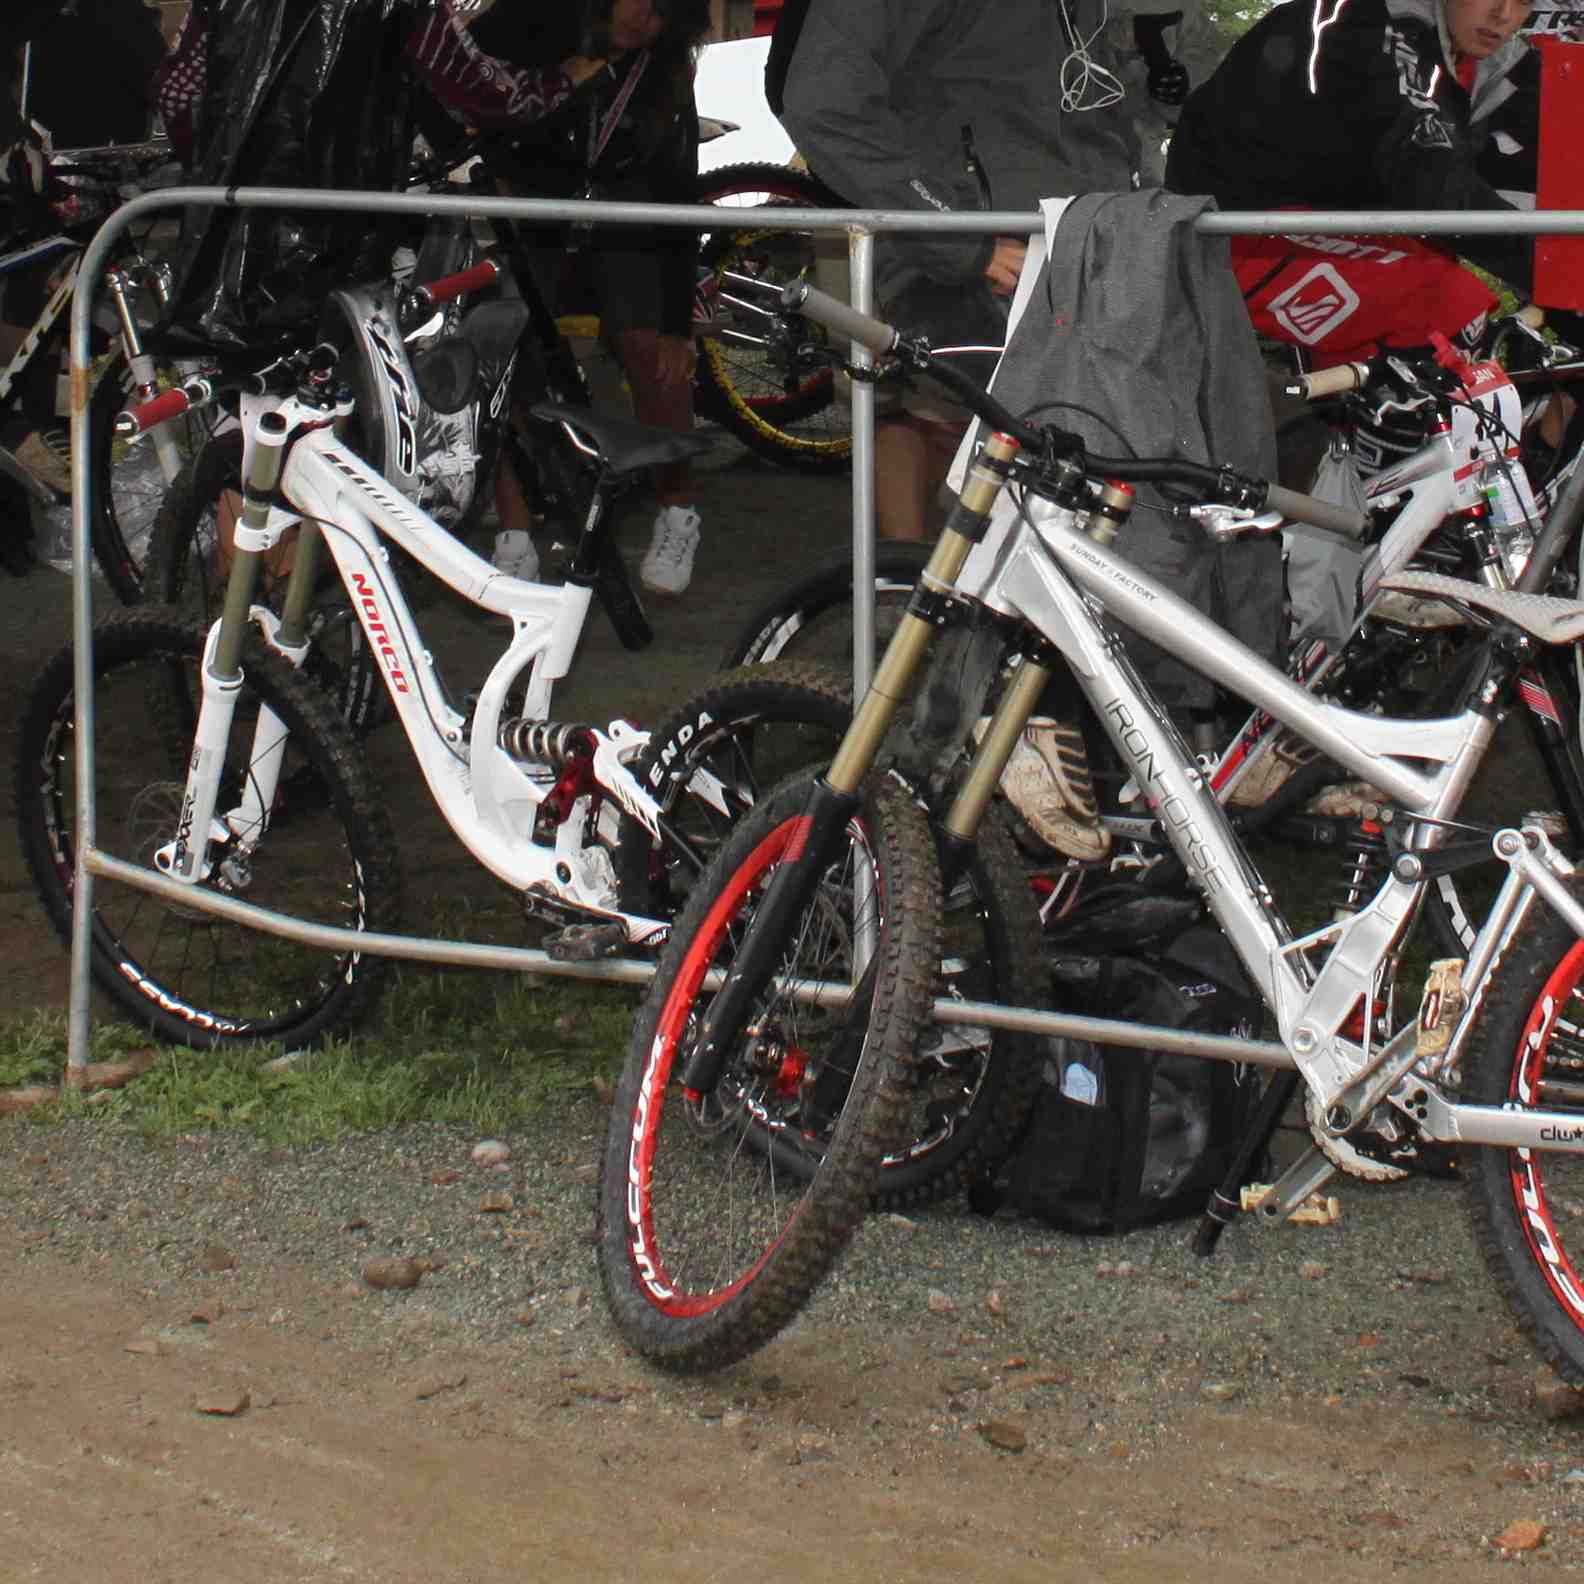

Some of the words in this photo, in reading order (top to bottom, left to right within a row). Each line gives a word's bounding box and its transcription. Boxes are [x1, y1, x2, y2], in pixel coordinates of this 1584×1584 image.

[1069, 542, 1108, 570] SUNDAY
[1113, 569, 1158, 602] FACTORY
[349, 572, 409, 694] NORCO
[648, 711, 714, 788] ENDA
[1106, 697, 1157, 783] IRON
[1152, 769, 1228, 895] HORSE
